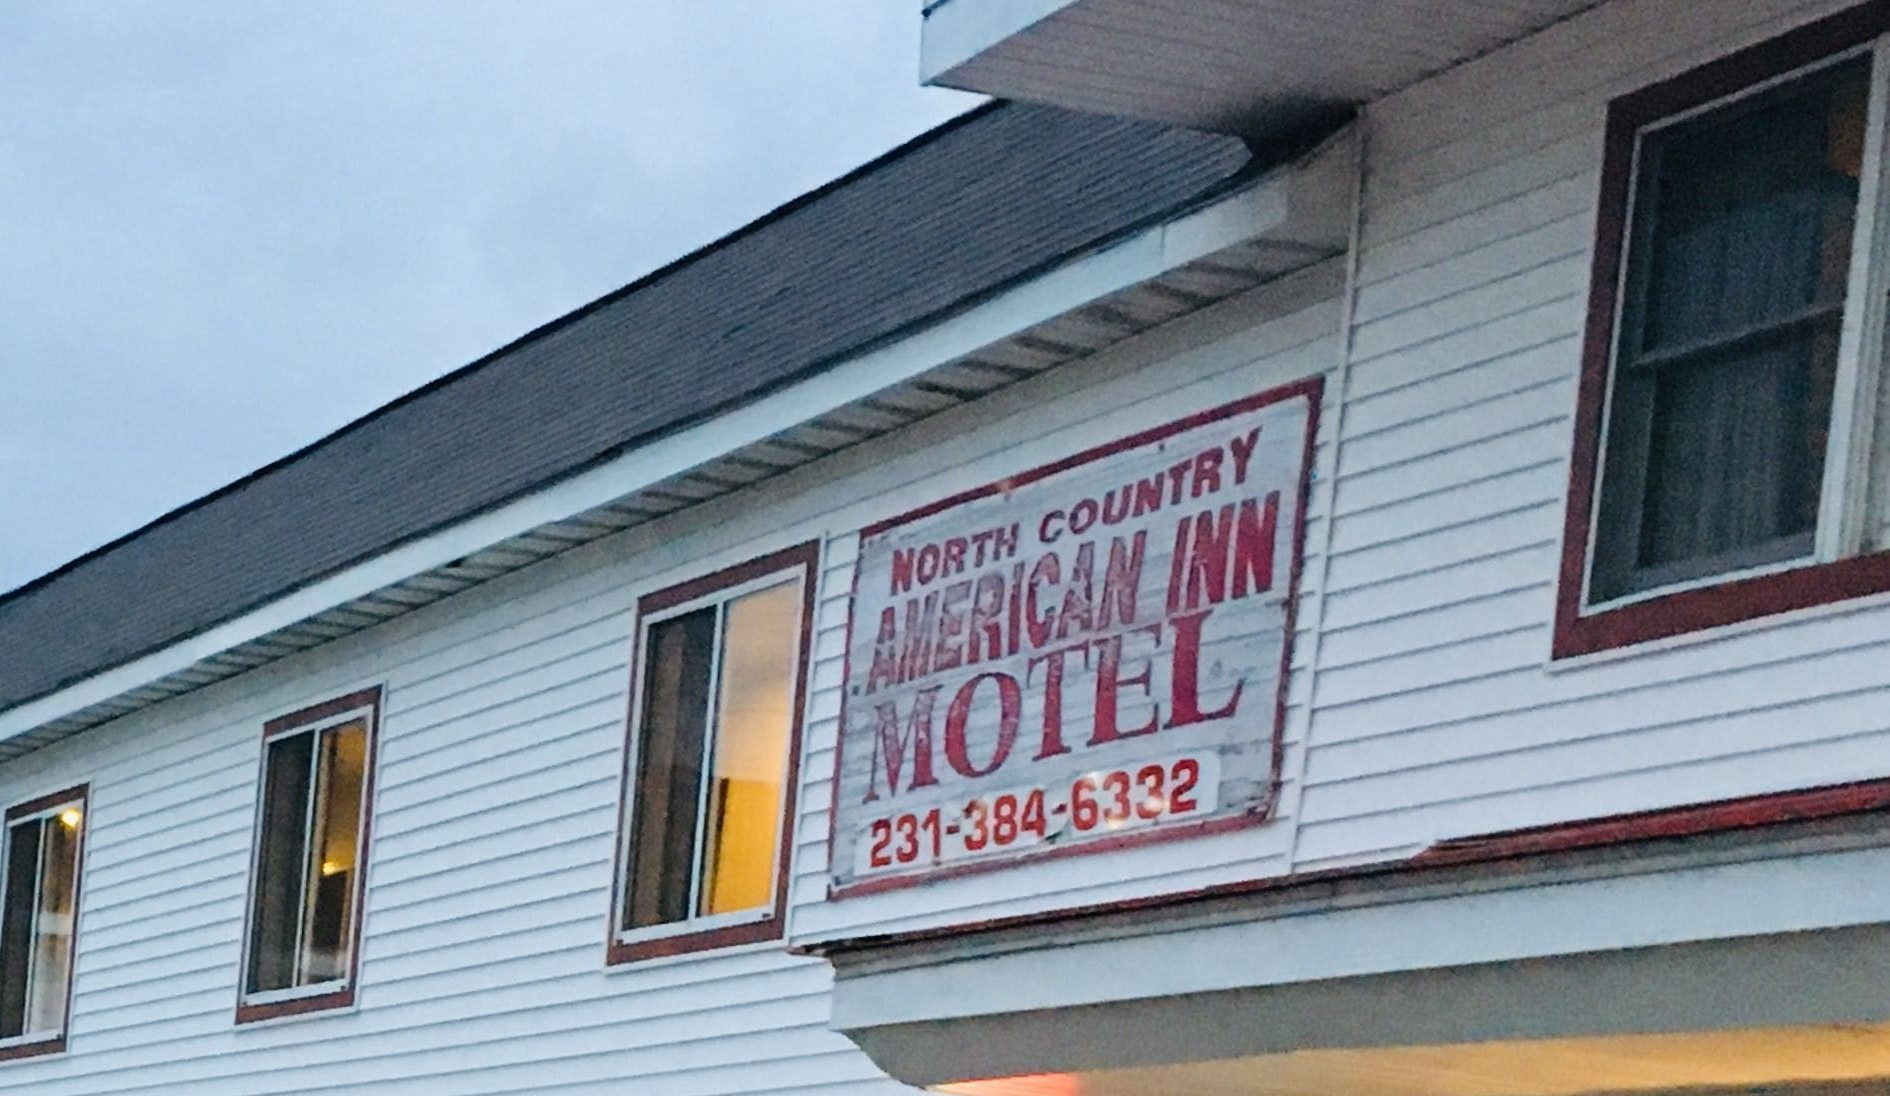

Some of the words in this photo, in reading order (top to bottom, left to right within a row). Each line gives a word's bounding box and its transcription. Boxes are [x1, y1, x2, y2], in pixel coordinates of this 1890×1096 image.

[866, 529, 1146, 694] AMERICAN
[1165, 490, 1280, 616] INN
[890, 523, 1019, 597] NORTH
[1038, 427, 1262, 544] COUNTRY
[861, 609, 1245, 804] MOTEL
[869, 758, 1200, 868] 231-384-6332
